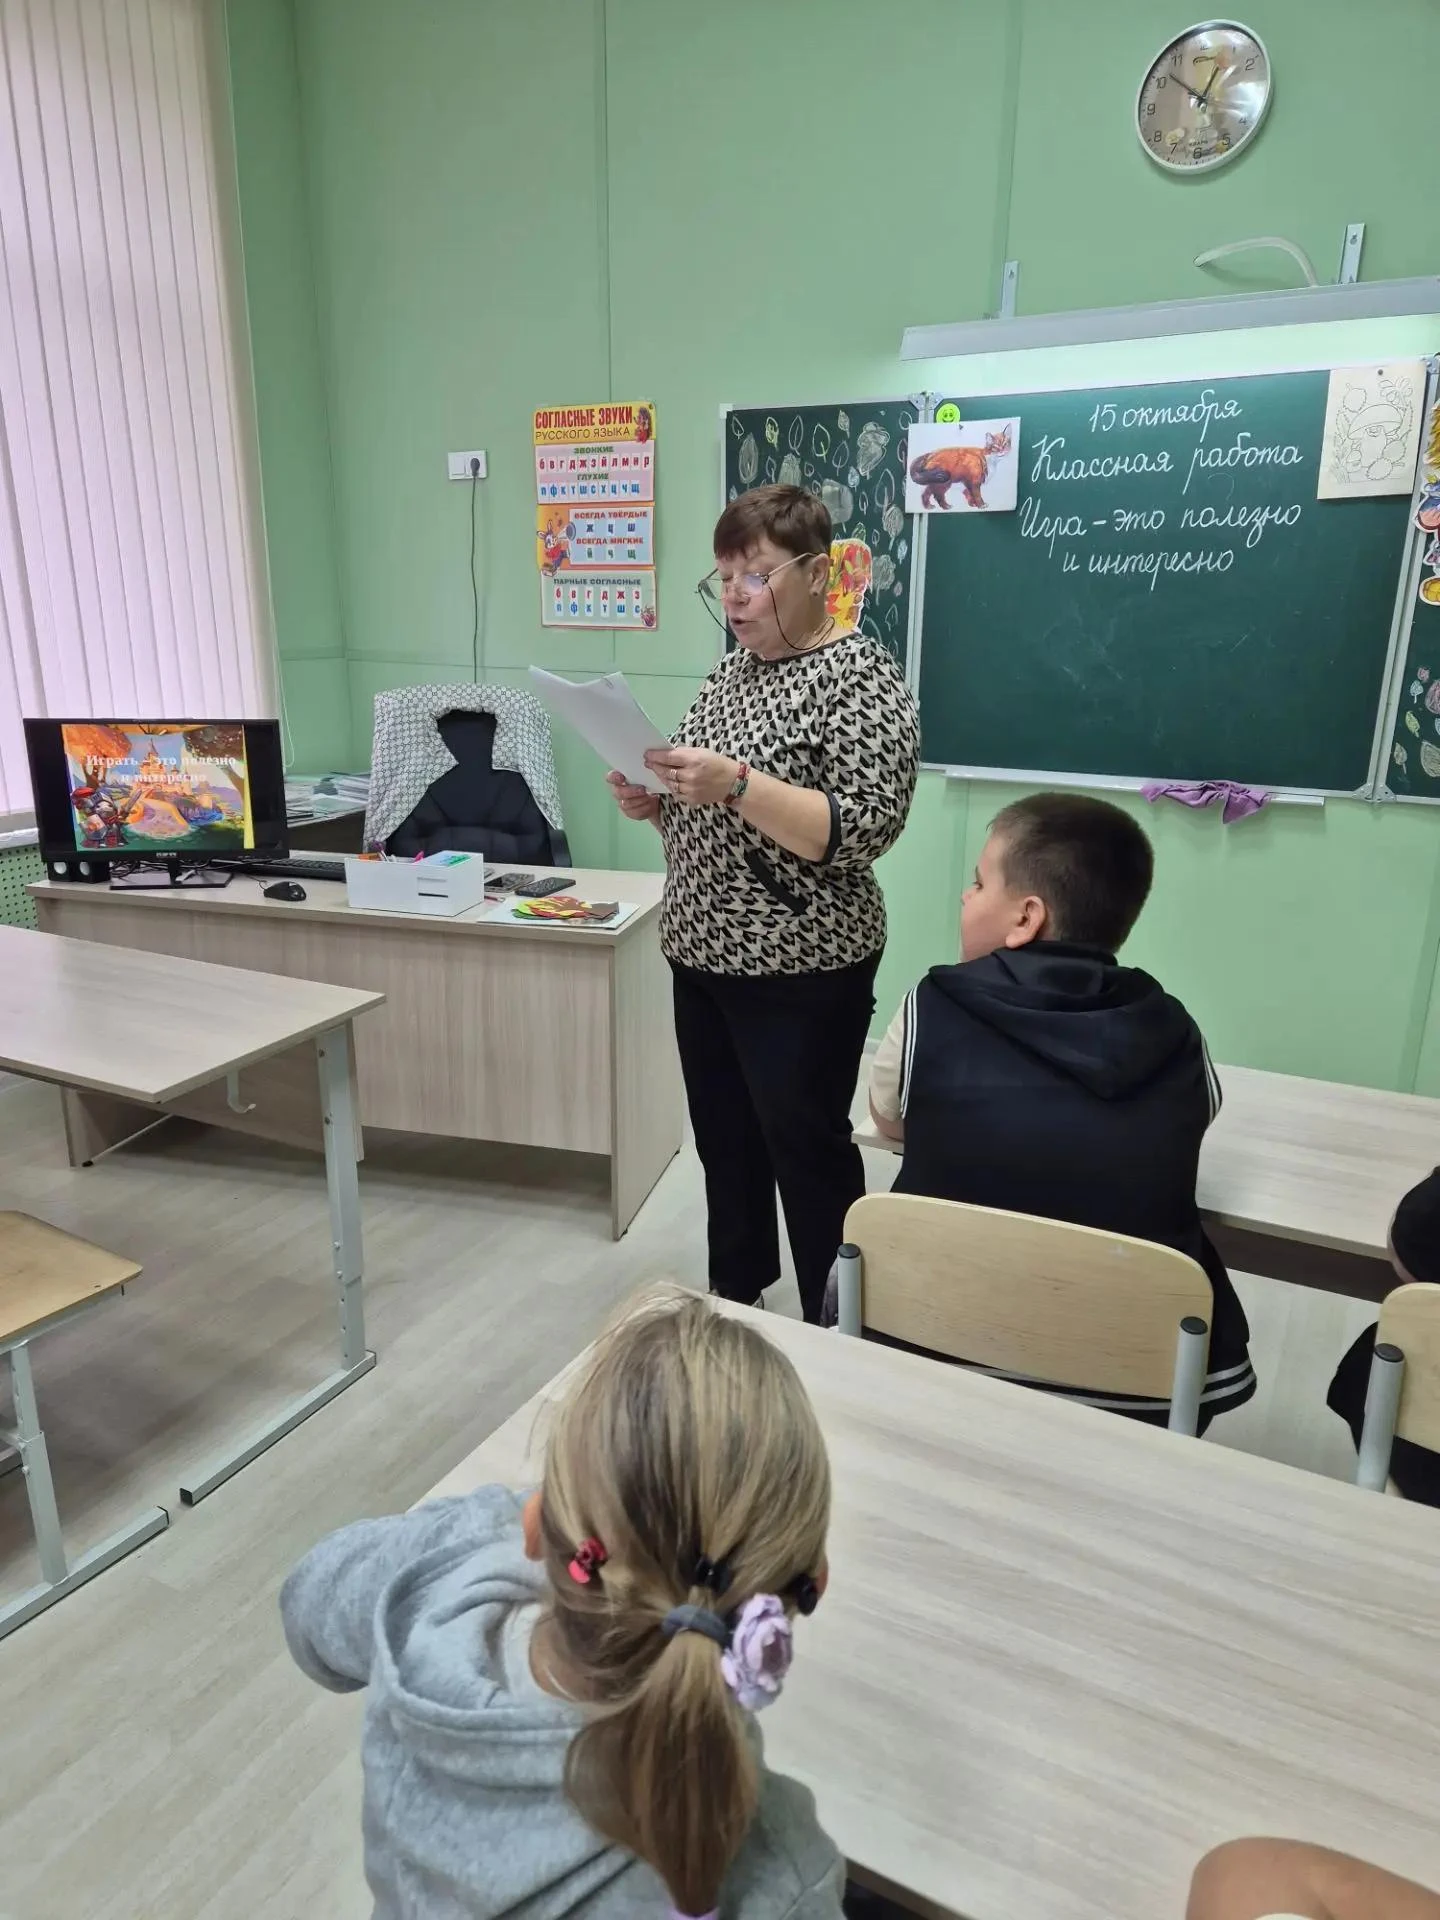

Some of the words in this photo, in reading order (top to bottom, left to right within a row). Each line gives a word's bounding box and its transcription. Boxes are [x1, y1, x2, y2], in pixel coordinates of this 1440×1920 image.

[1245, 58, 1255, 71] 2
[1147, 104, 1155, 115] 9
[1154, 131, 1162, 142] 8
[1170, 143, 1178, 154] 7
[1193, 148, 1202, 159] 6
[536, 409, 595, 429] СОГЛАСНЫЕ
[599, 407, 632, 425] ЗВУКИ
[1089, 404, 1117, 432] 15
[1122, 389, 1242, 442] октября
[536, 430, 590, 440] РУССКОГО
[593, 427, 630, 437] ЯЗЫКА
[574, 446, 614, 454] ЗВОНКИЕ
[1031, 434, 1173, 483] Классная
[1183, 432, 1303, 495] работа
[574, 512, 605, 520] ВСЕГДА
[1020, 496, 1087, 558] Игра
[1113, 509, 1165, 531] это
[1180, 504, 1302, 548] полезно
[1063, 551, 1079, 573] и
[1089, 549, 1234, 591] интересно
[86, 755, 137, 768] Играть
[181, 757, 236, 765] полезно
[134, 775, 206, 784] интересно
